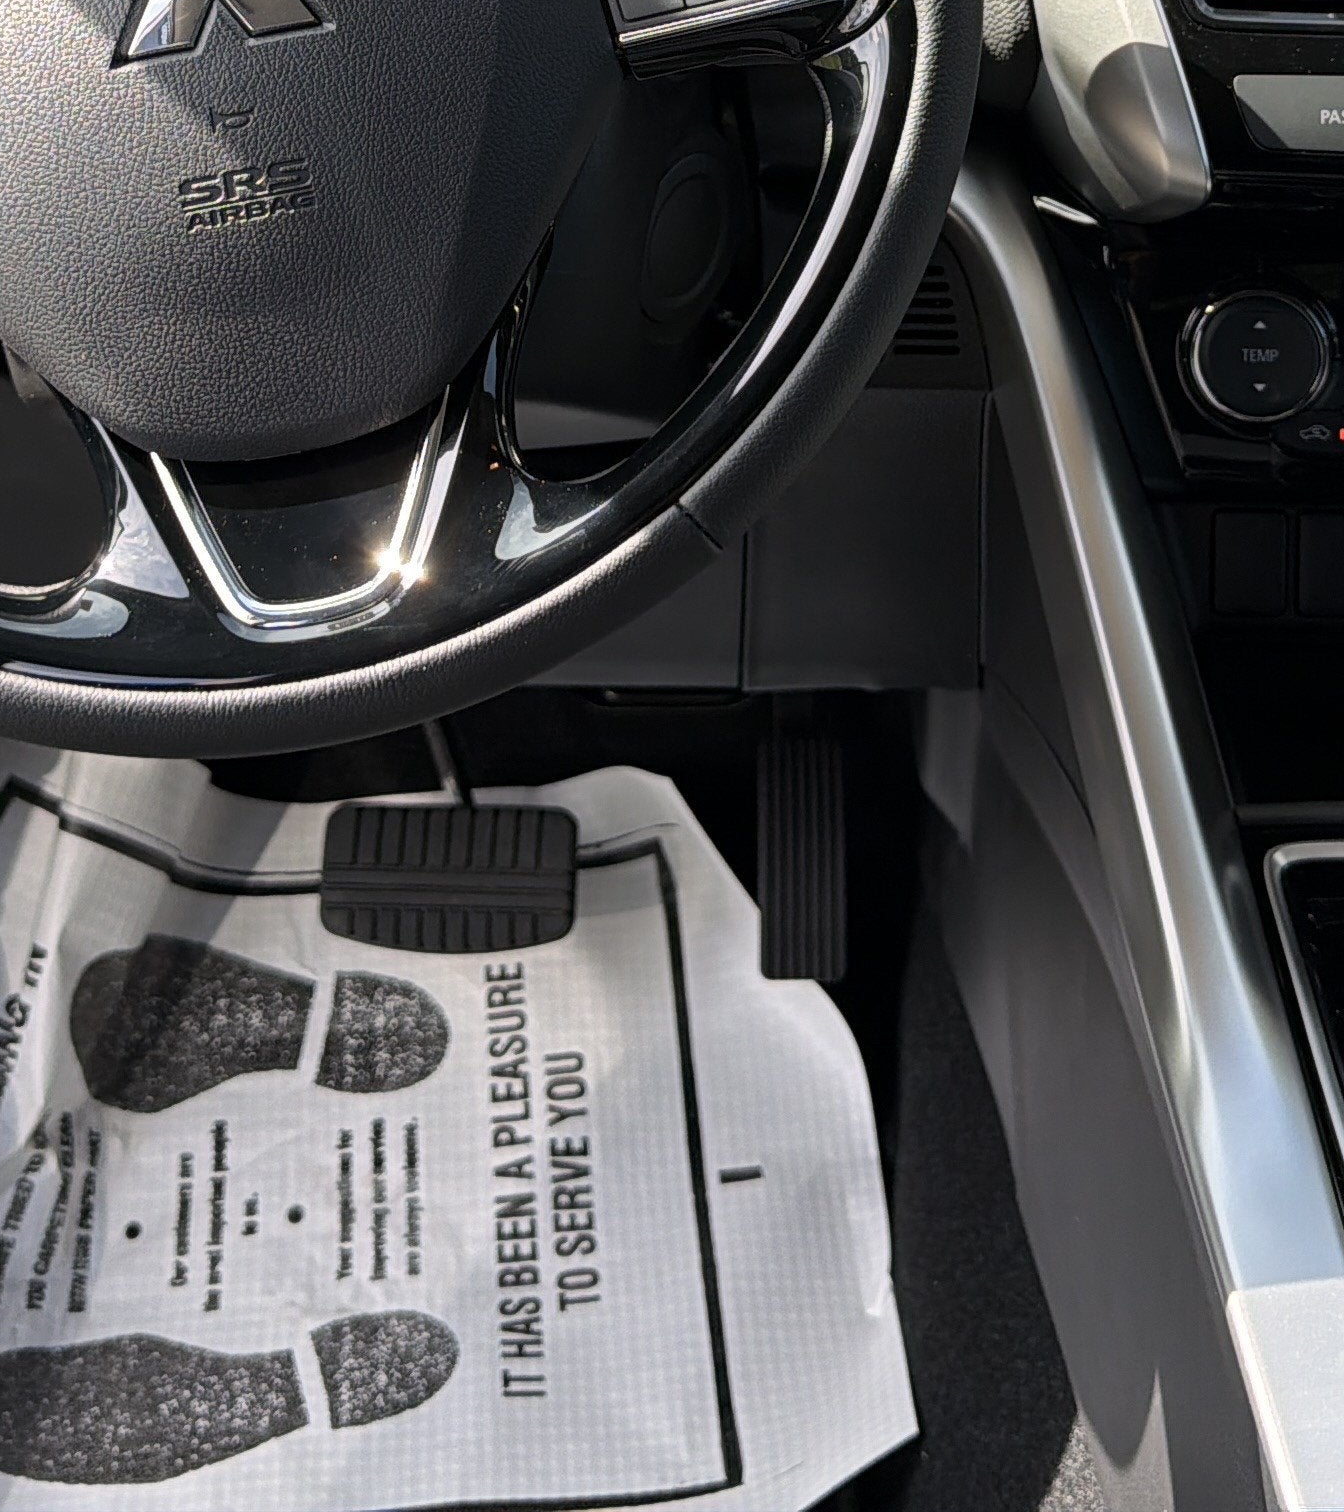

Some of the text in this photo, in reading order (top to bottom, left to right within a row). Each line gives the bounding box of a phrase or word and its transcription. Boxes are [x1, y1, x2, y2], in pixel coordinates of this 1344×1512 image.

[178, 159, 313, 209] SRS
[187, 195, 318, 234] AIRBAG
[1242, 348, 1279, 362] TEMP
[484, 960, 548, 1399] IT HAS BEEN A PLEASURE
[543, 1050, 601, 1311] TO SERVE YOU
